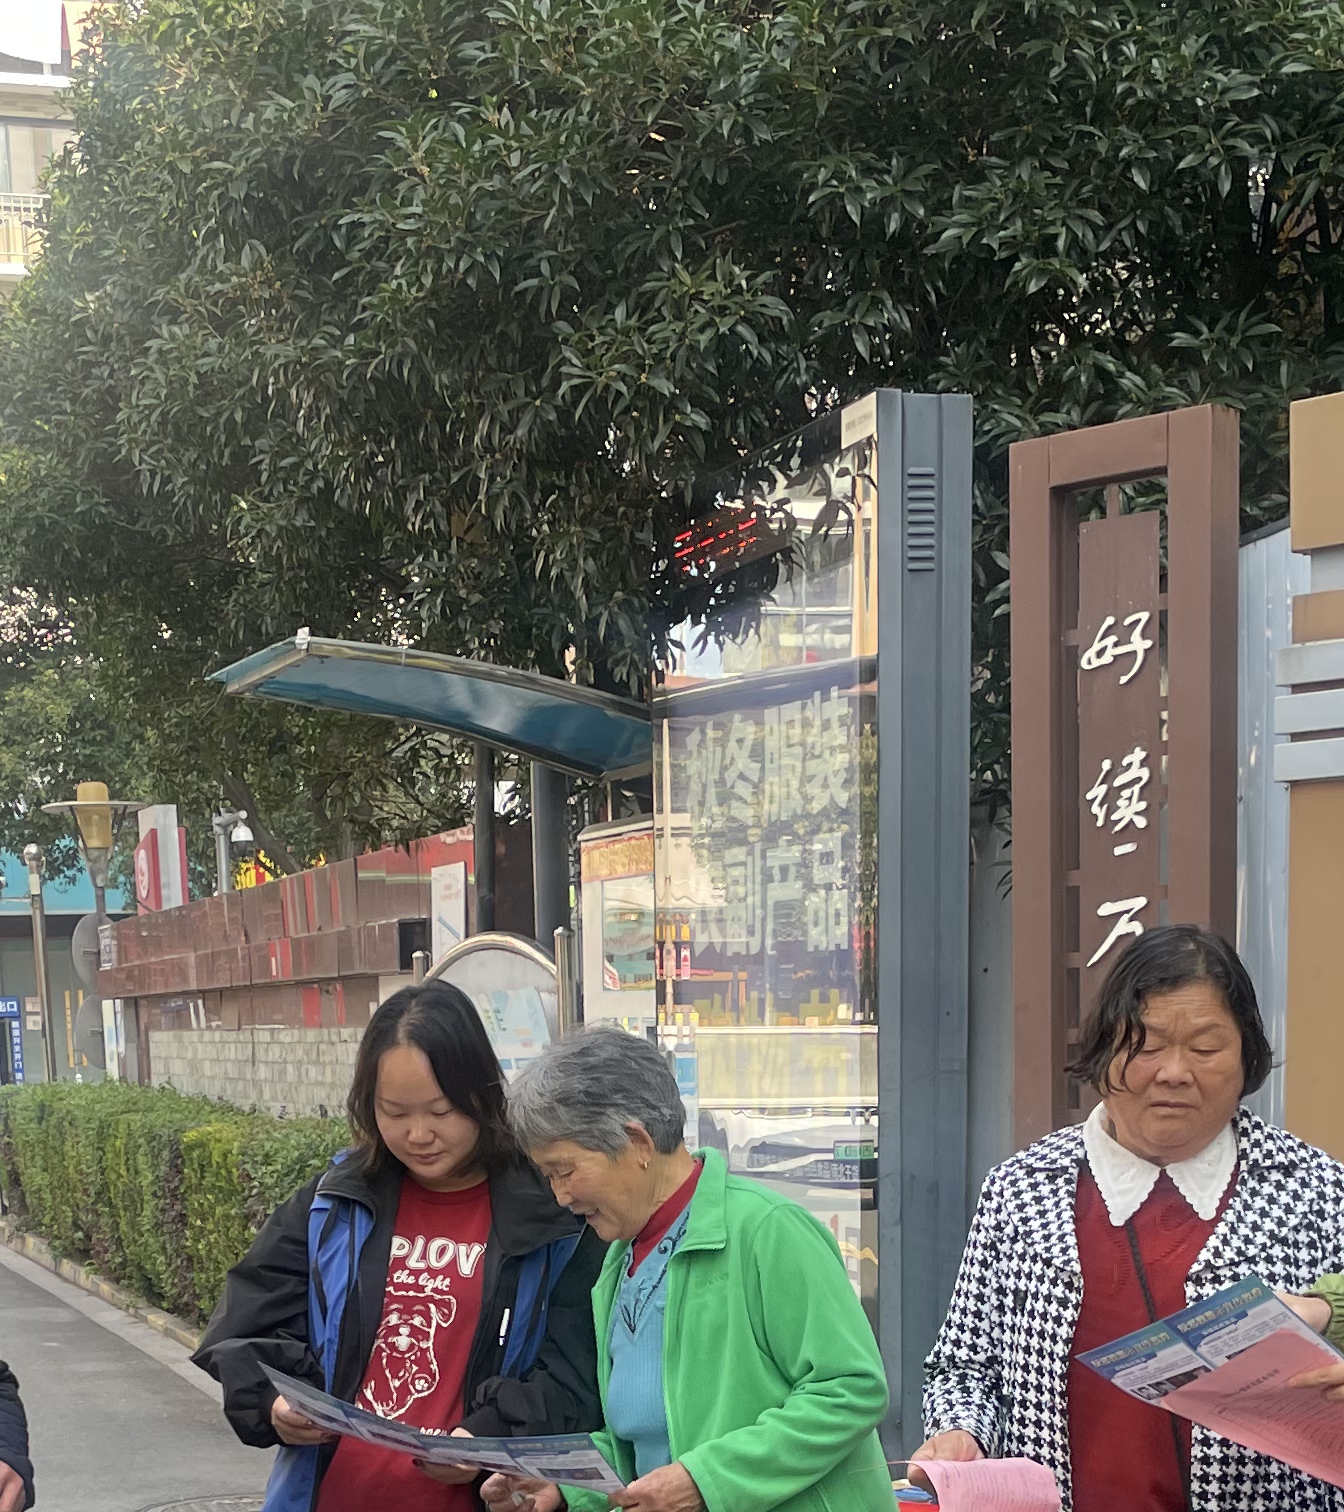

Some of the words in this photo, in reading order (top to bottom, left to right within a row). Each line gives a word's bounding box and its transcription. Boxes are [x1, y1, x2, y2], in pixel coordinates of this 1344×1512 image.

[389, 1234, 487, 1278] PLOV
[393, 1269, 416, 1284] the
[418, 1272, 451, 1293] light
